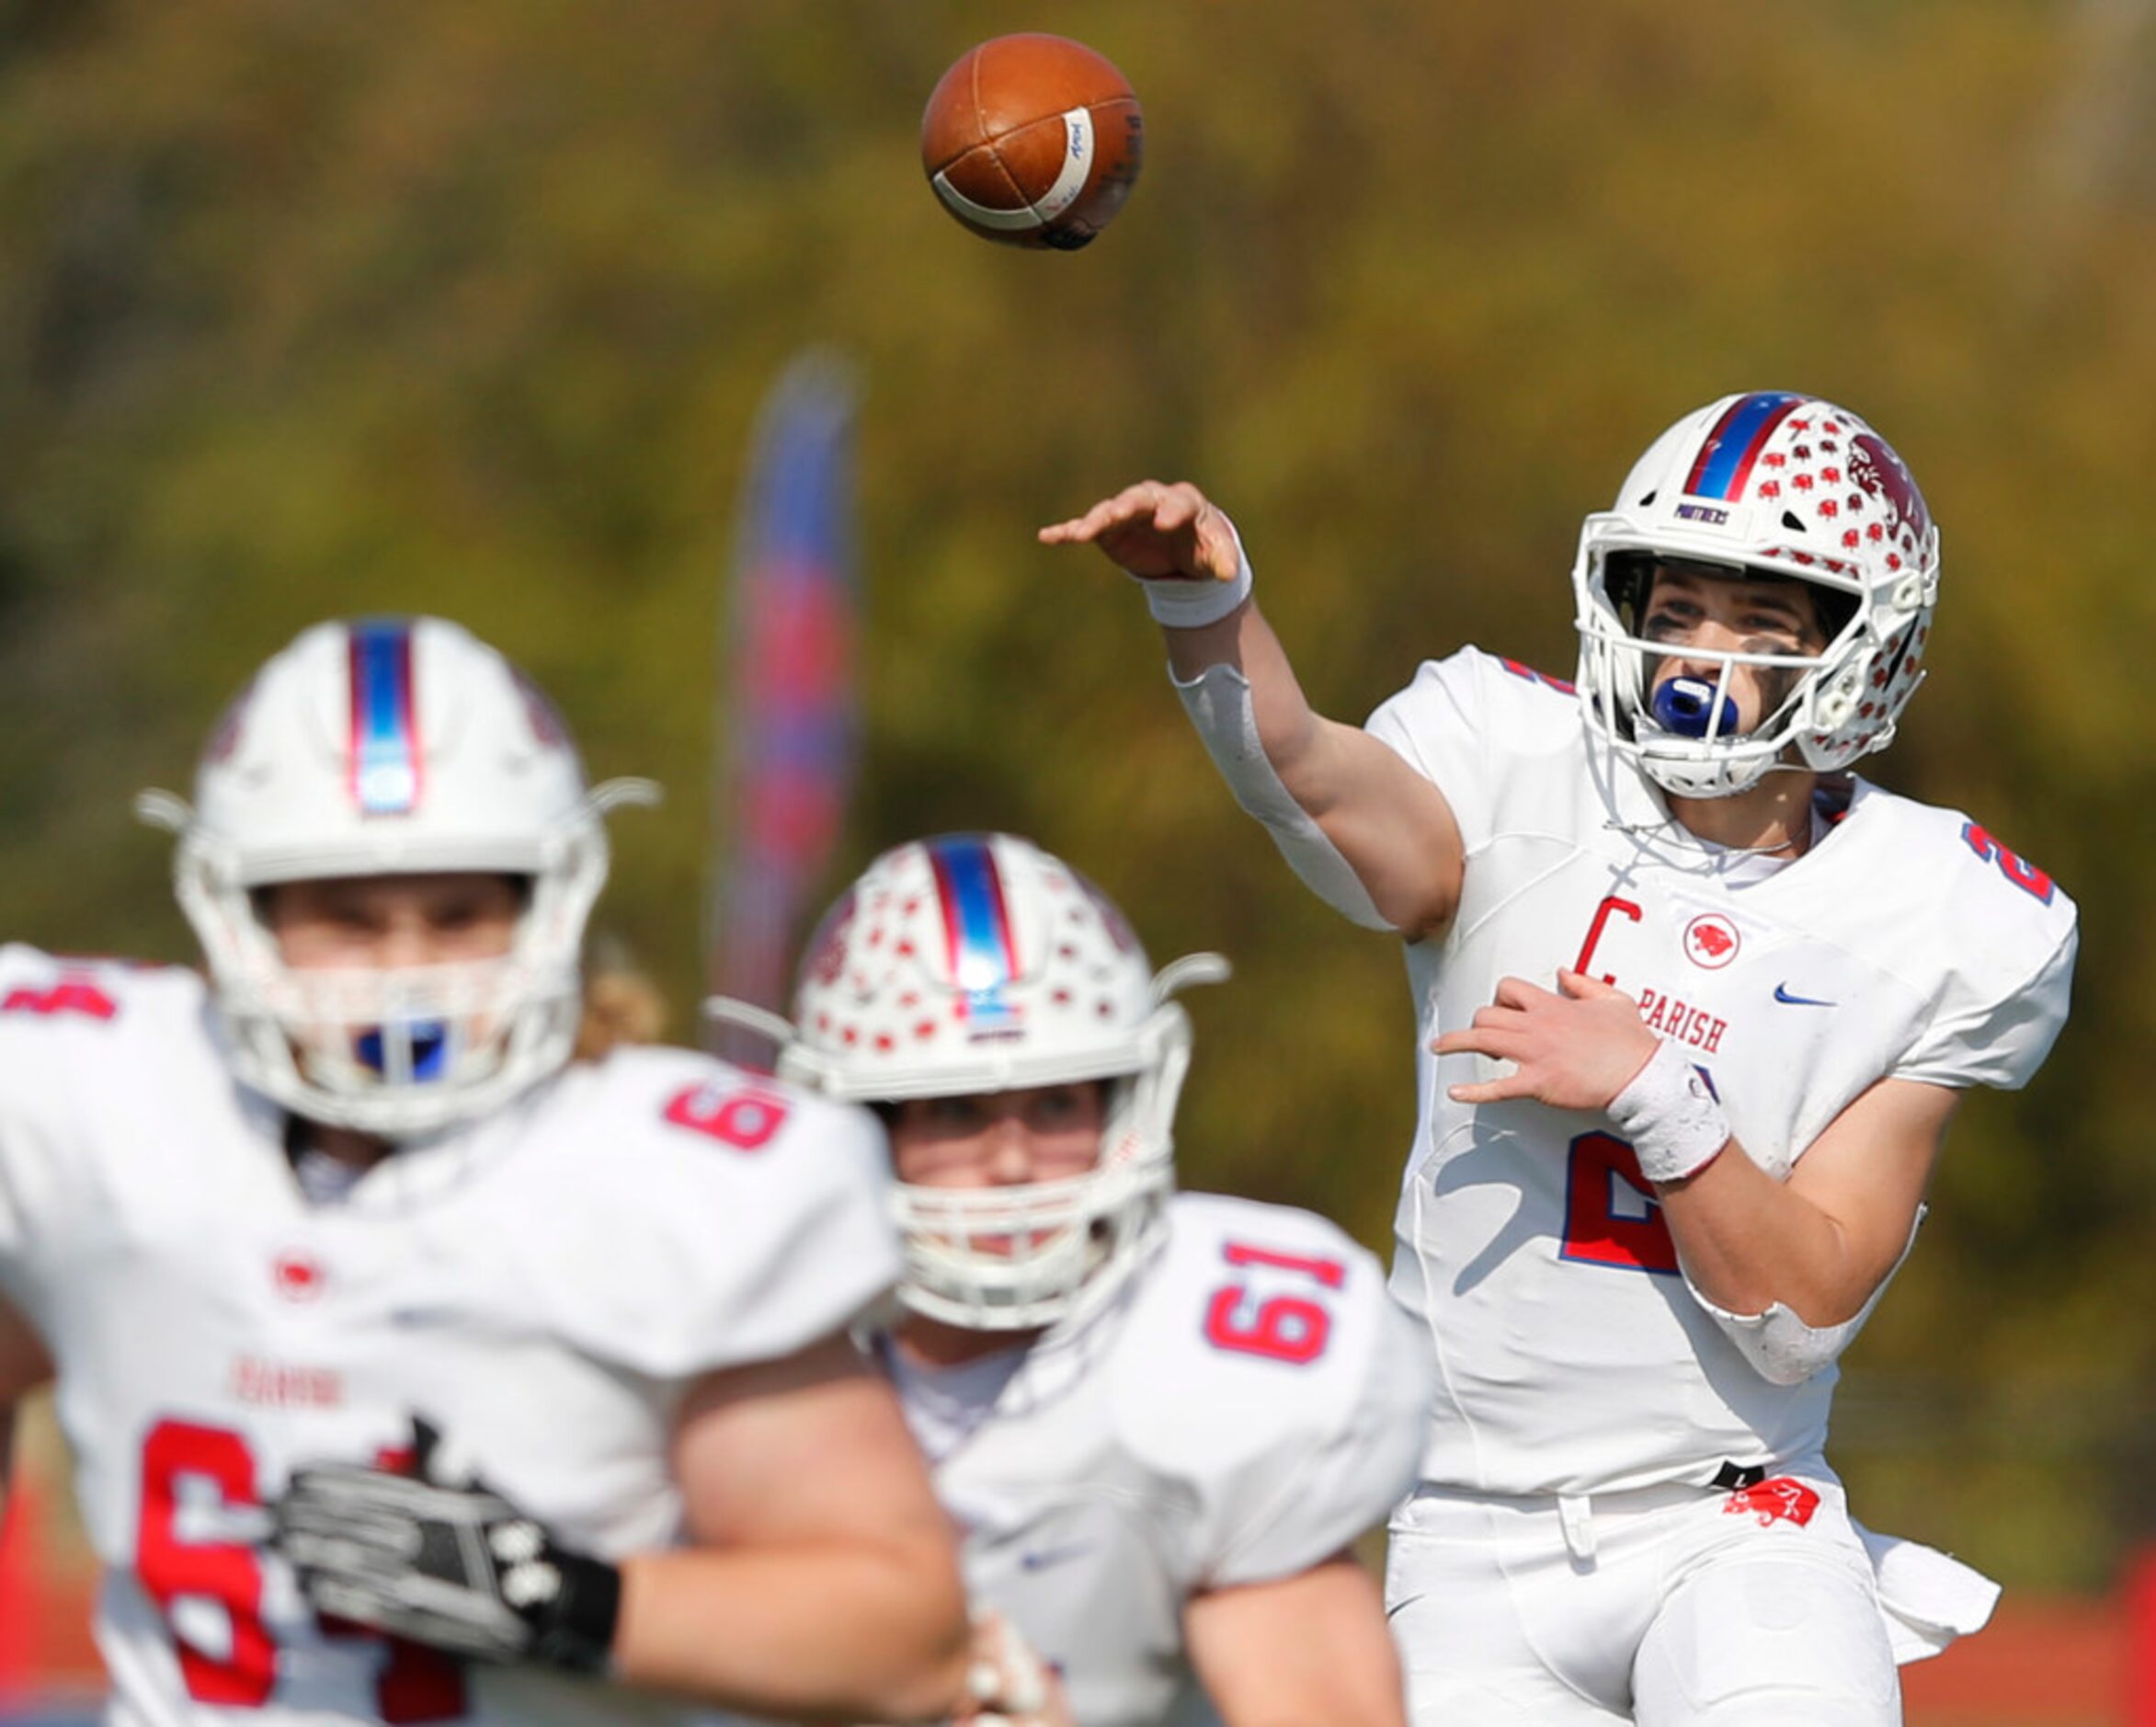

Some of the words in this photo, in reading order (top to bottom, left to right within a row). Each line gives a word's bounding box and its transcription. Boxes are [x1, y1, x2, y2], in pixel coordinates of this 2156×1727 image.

[1637, 988, 1728, 1054] PARISH
[662, 1060, 796, 1151] 6
[1200, 1239, 1346, 1366] 61
